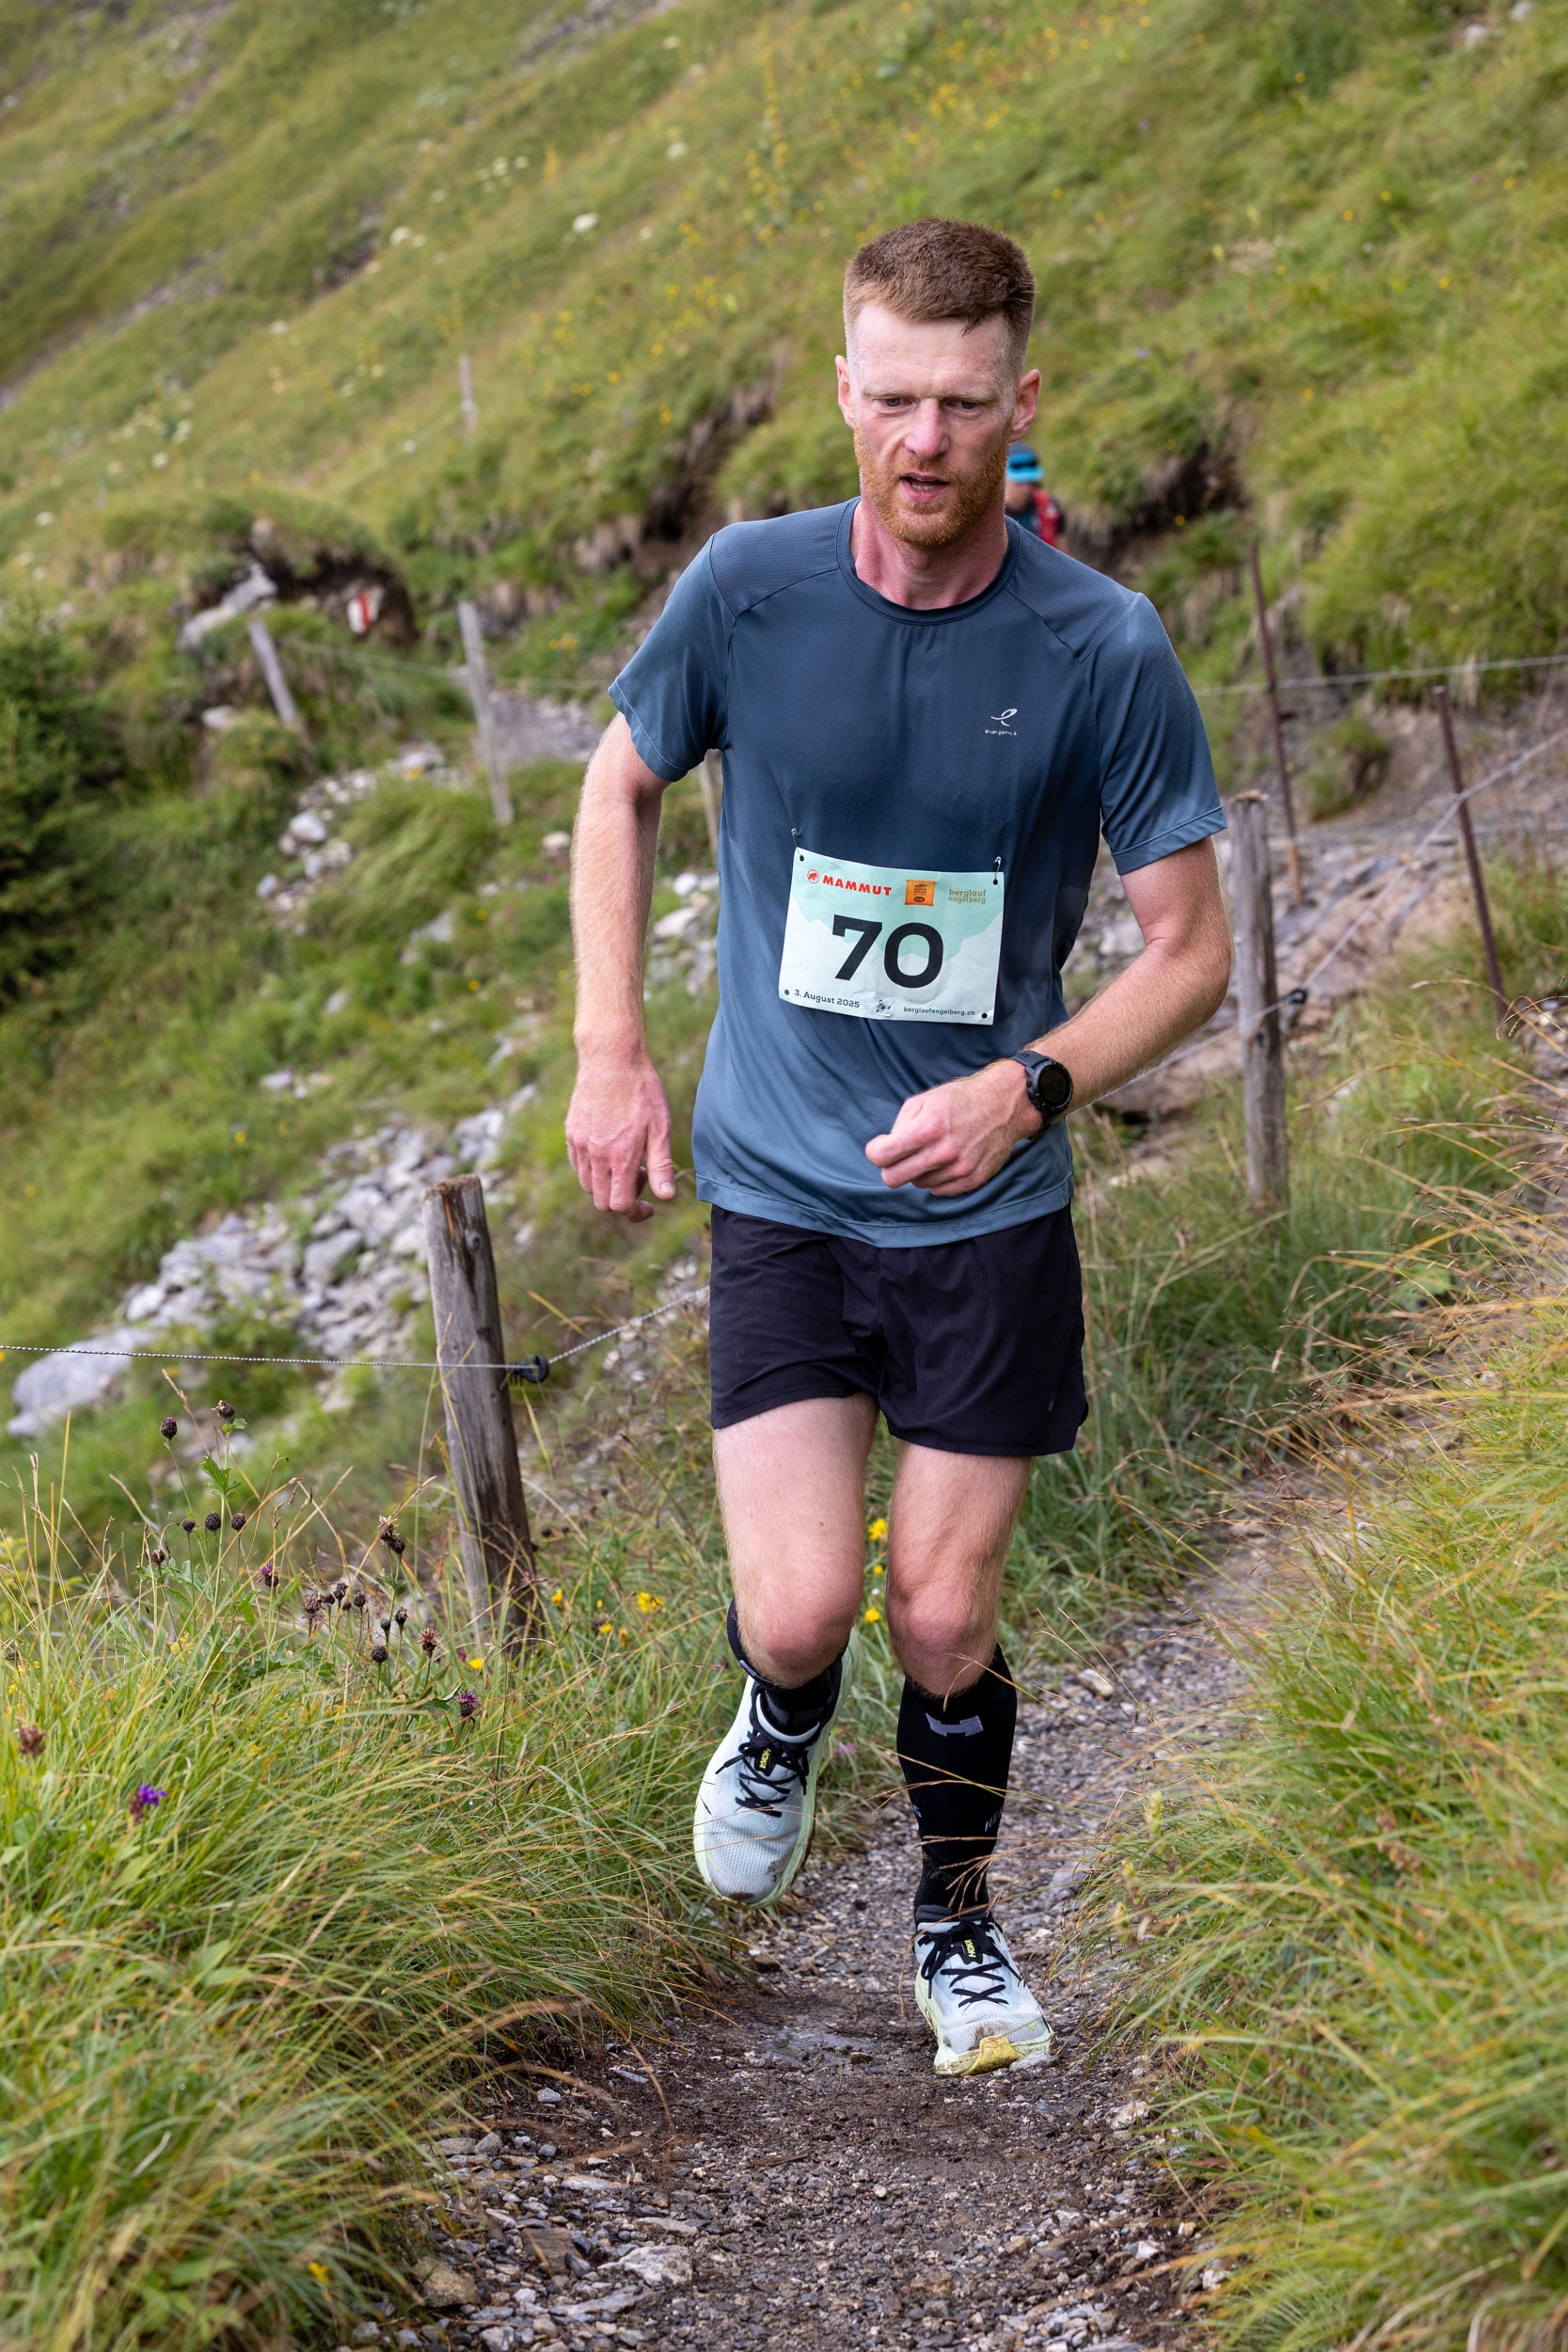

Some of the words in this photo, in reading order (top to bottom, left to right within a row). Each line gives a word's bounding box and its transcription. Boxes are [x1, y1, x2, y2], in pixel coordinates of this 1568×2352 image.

[822, 875, 892, 896] MAMMUT
[949, 888, 987, 898] berglauf
[948, 896, 987, 905] engelberg
[832, 914, 944, 989] 70
[794, 989, 802, 997] 3.
[803, 991, 835, 1004] August
[836, 997, 861, 1009] 2025
[903, 1007, 975, 1017] berglaufengelberg.ch
